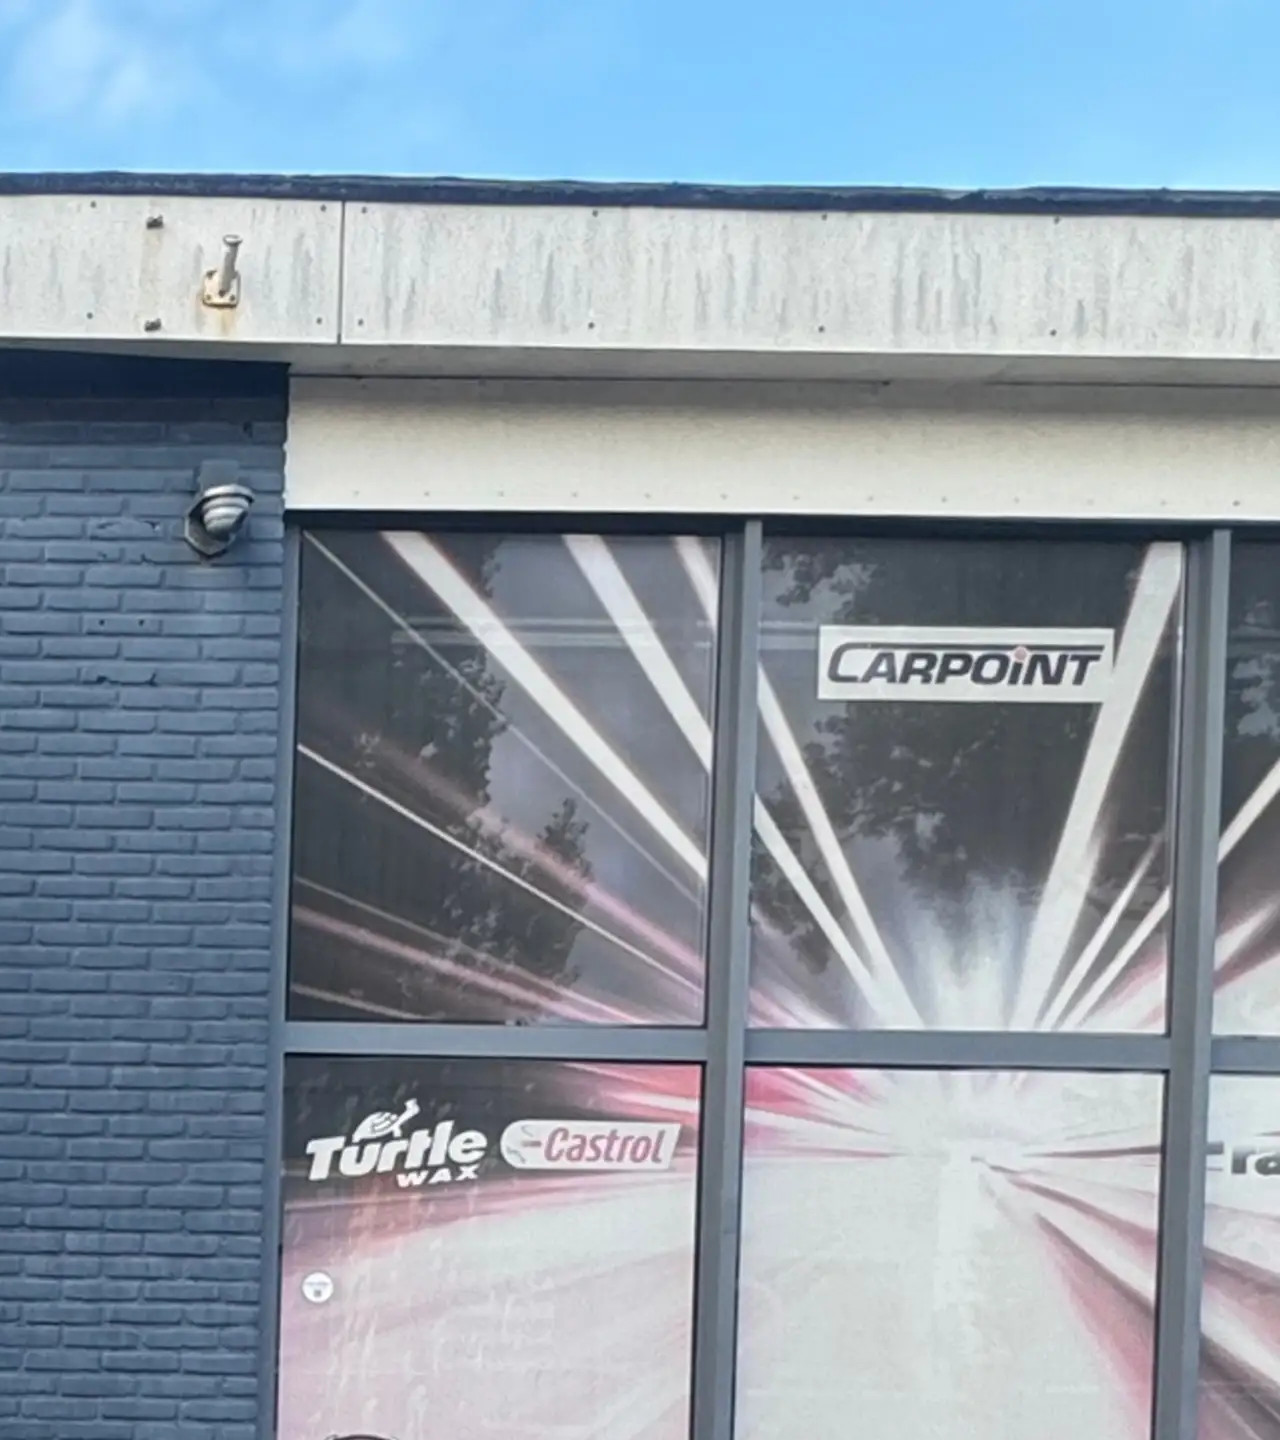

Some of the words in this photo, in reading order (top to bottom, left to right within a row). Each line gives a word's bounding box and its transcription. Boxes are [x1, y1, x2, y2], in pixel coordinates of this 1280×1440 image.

[305, 1119, 488, 1181] Turtle
[543, 1127, 666, 1164] Castrol
[396, 1164, 480, 1188] WAX
